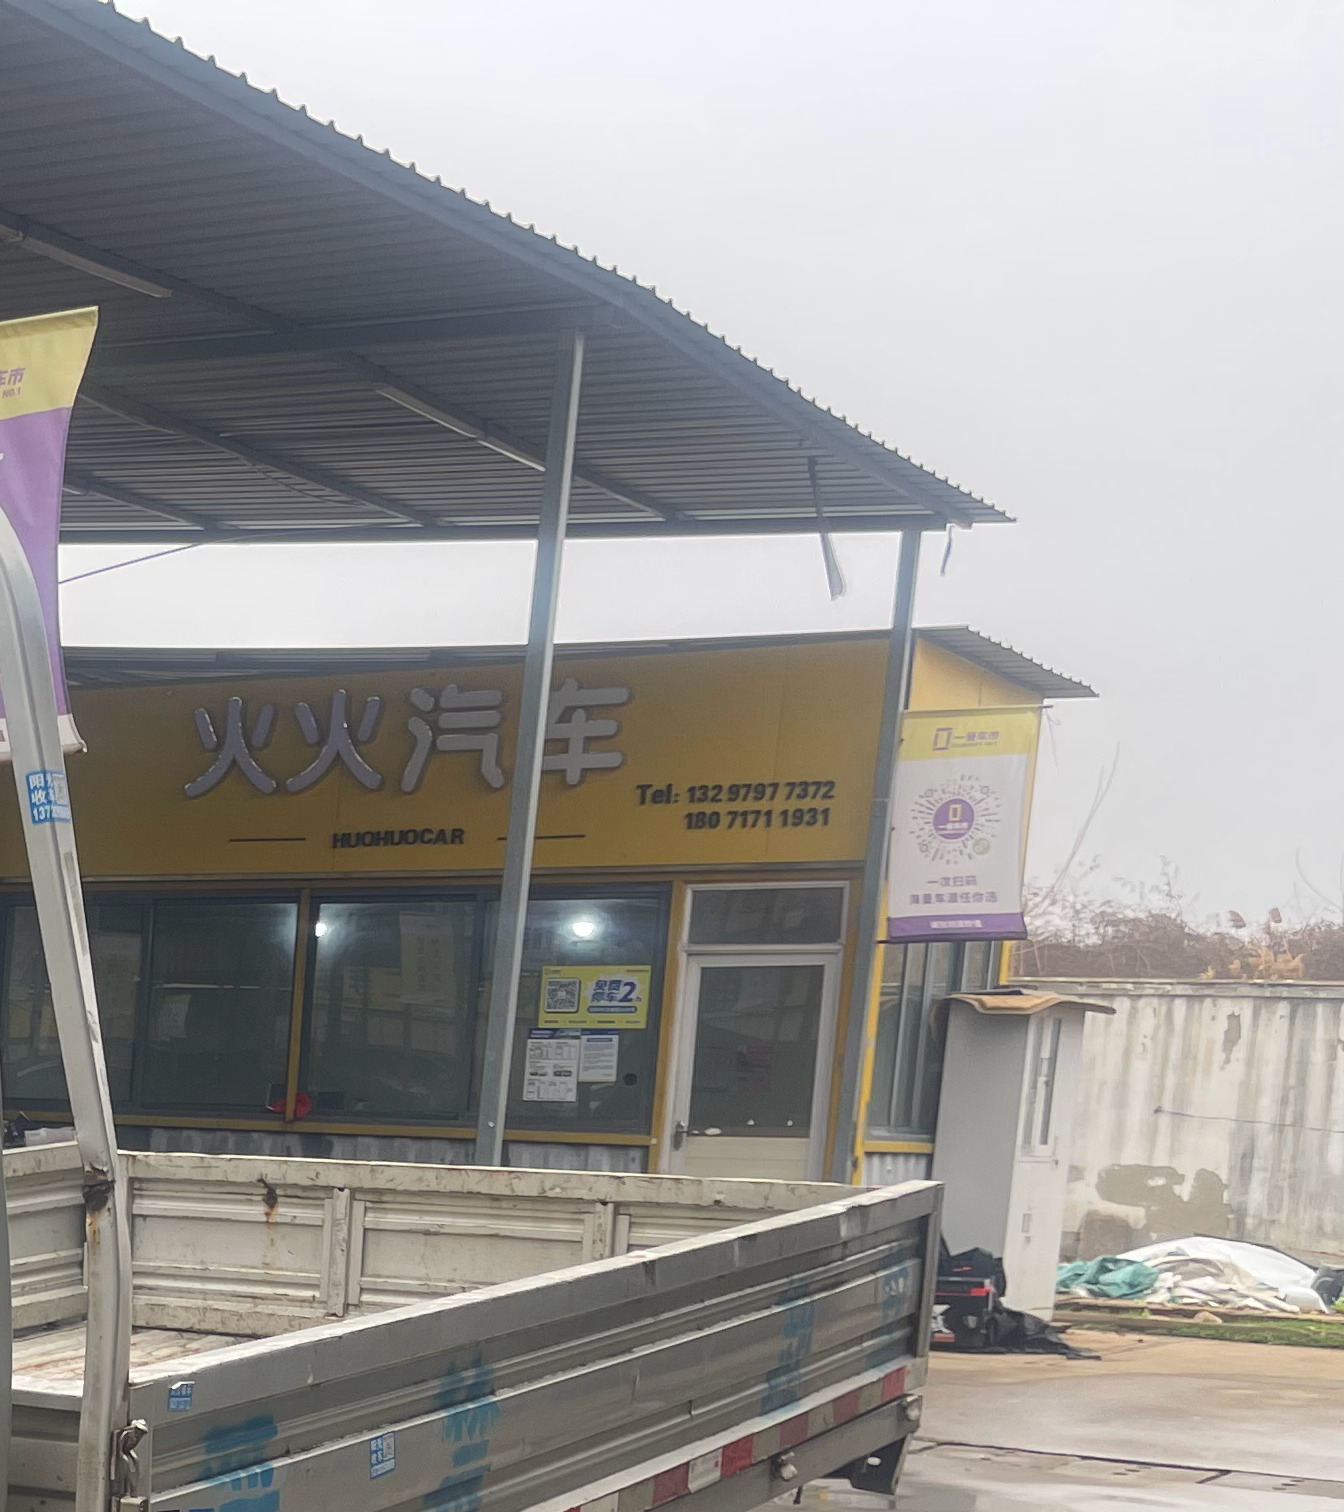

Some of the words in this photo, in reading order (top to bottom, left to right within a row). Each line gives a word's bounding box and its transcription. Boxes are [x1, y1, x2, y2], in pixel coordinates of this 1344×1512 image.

[184, 679, 630, 797] 火火汽车
[636, 783, 680, 806] Tel:
[687, 784, 723, 804] 132
[727, 782, 780, 803] 9797
[784, 780, 837, 800] 7372
[726, 809, 774, 830] 7171
[780, 807, 831, 828] 1931
[331, 827, 465, 850] HUOHUOCAR
